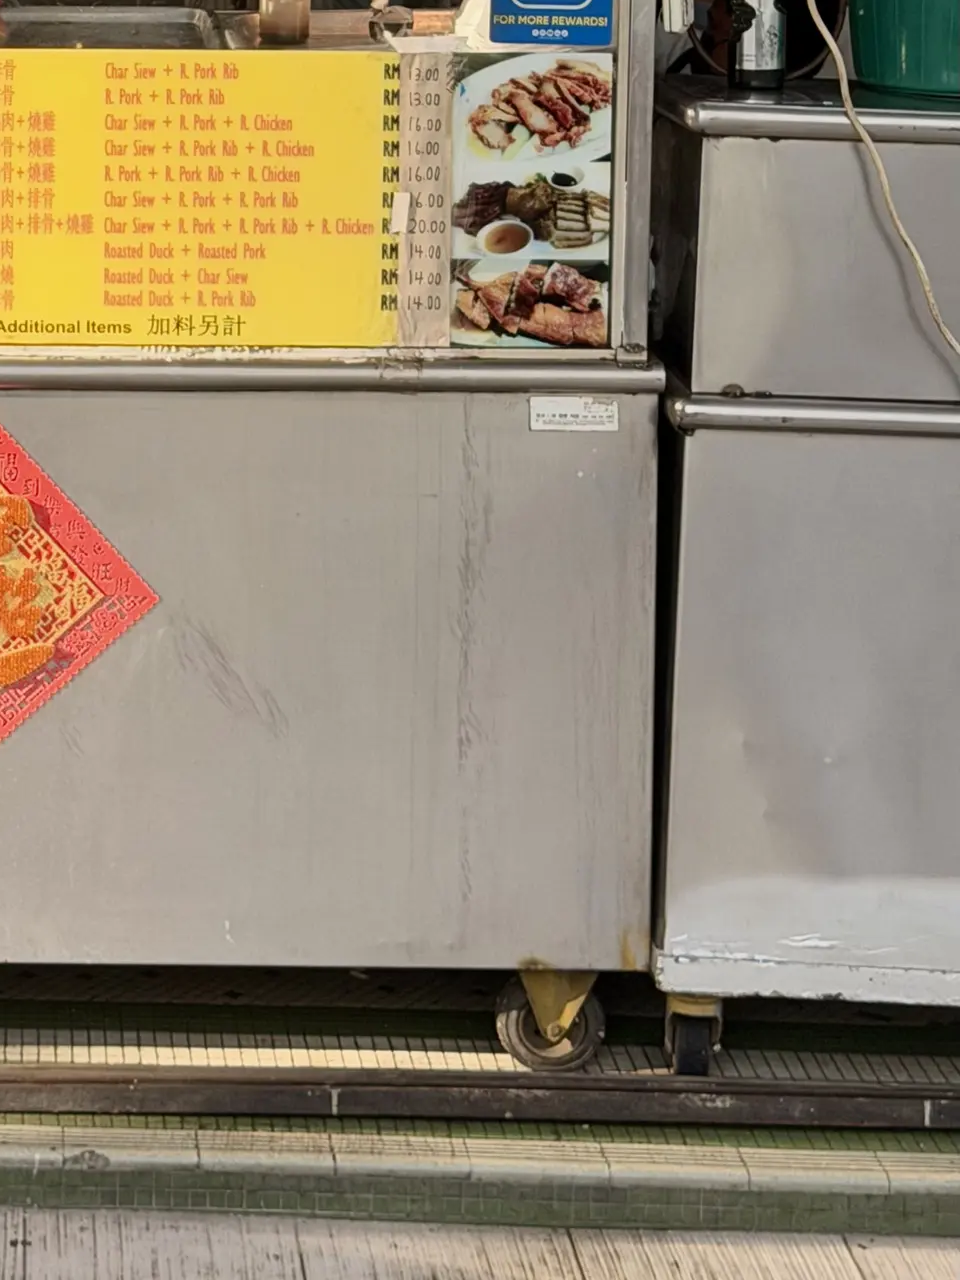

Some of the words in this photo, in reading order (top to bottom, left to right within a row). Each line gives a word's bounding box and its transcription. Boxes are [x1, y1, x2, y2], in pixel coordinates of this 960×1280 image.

[493, 14, 515, 25] FOR
[518, 15, 549, 26] MORE
[552, 16, 608, 27] REWARDS!
[105, 62, 129, 80] Char
[134, 62, 156, 79] Siew
[194, 63, 216, 79] Pork
[223, 62, 239, 80] Rib
[383, 63, 400, 80] RM
[119, 88, 142, 105] Pork
[180, 88, 203, 105] Pork
[209, 88, 225, 105] Rib
[383, 89, 400, 106] RM
[105, 114, 128, 131] Char
[134, 113, 156, 131] Siew
[194, 114, 216, 131] Pork
[254, 114, 293, 131] Chicken
[383, 115, 400, 131] RM
[105, 139, 128, 156] Char
[133, 140, 156, 157] Siew
[193, 140, 216, 156] Pork
[222, 140, 238, 156] Rib
[276, 140, 314, 157] Chicken
[383, 140, 400, 157] RM
[119, 165, 141, 182] Pork
[179, 166, 202, 182] Pork
[208, 166, 224, 182] Rib
[262, 166, 300, 183] Chicken
[382, 166, 400, 183] RM
[104, 191, 127, 208] Char
[133, 191, 155, 208] Siew
[193, 191, 215, 208] Pork
[253, 191, 276, 208] Pork
[282, 192, 298, 208] Rib
[104, 217, 127, 234] Char
[132, 217, 155, 234] Siew
[193, 217, 215, 234] Pork
[253, 218, 276, 234] Pork
[282, 218, 298, 235] Rib
[336, 218, 374, 235] Chicken
[104, 242, 143, 259] Roasted
[149, 242, 174, 259] Duck
[198, 242, 237, 259] Roasted
[243, 243, 266, 259] Pork
[381, 243, 399, 260] RM
[104, 268, 143, 284] Roasted
[149, 268, 174, 284] Duck
[197, 268, 220, 284] Char
[226, 268, 248, 284] Siew
[381, 269, 398, 286] RM
[104, 290, 143, 307] Roasted
[149, 290, 173, 307] Duck
[212, 291, 234, 307] Pork
[240, 290, 256, 307] Rib
[380, 294, 398, 311] RM
[86, 320, 132, 335] Items
[146, 314, 247, 337] 加料另計
